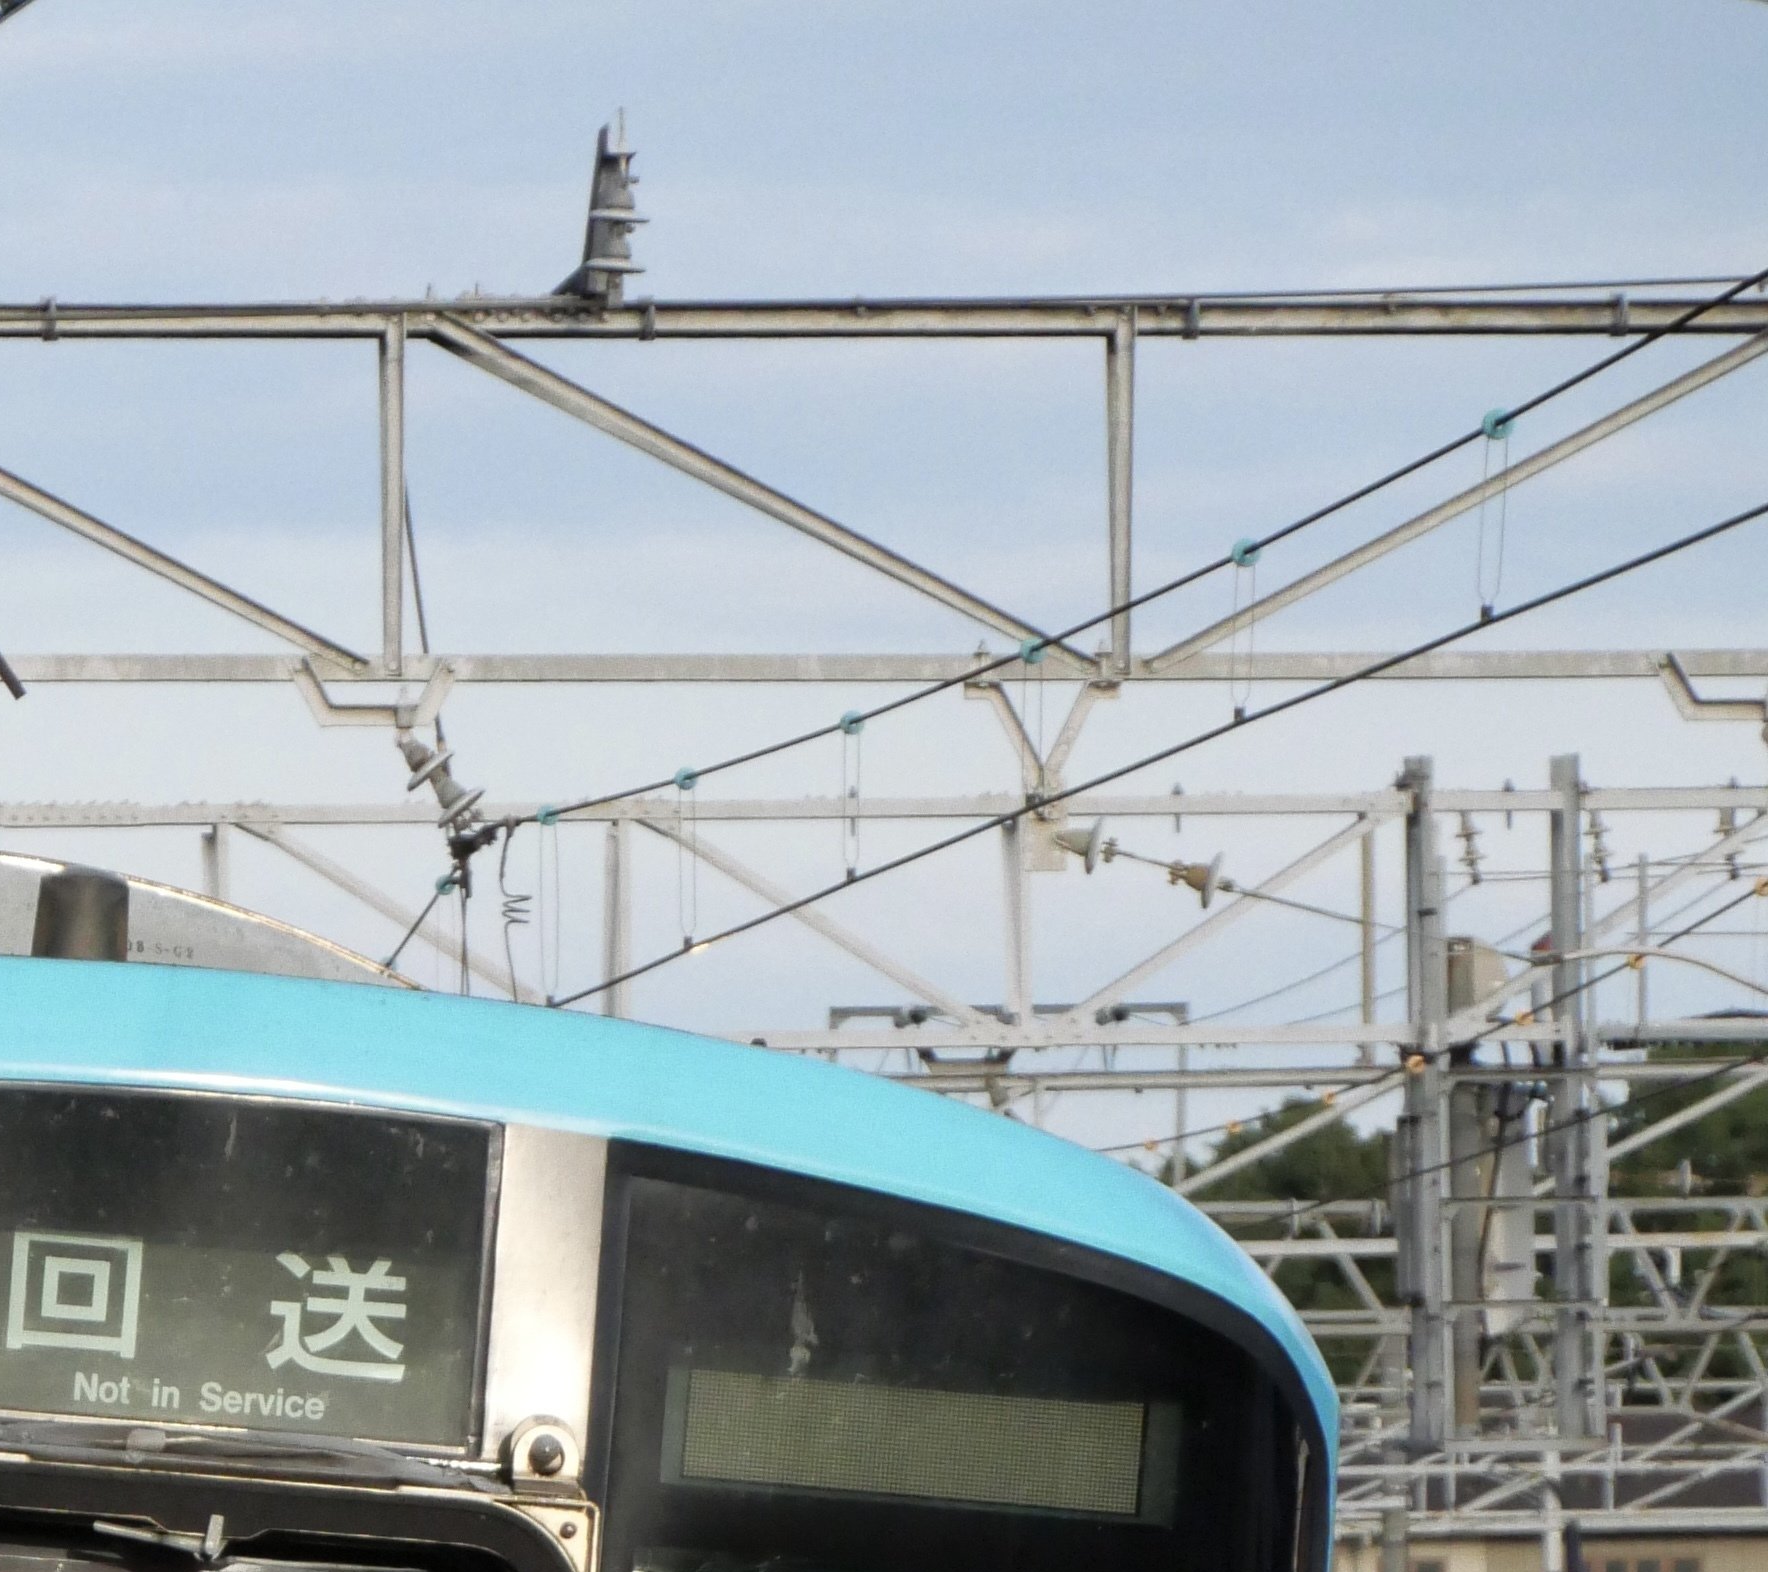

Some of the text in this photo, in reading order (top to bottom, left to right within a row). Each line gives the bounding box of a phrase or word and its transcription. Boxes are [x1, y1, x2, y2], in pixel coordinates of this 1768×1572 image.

[73, 1371, 326, 1421] Not in Service
